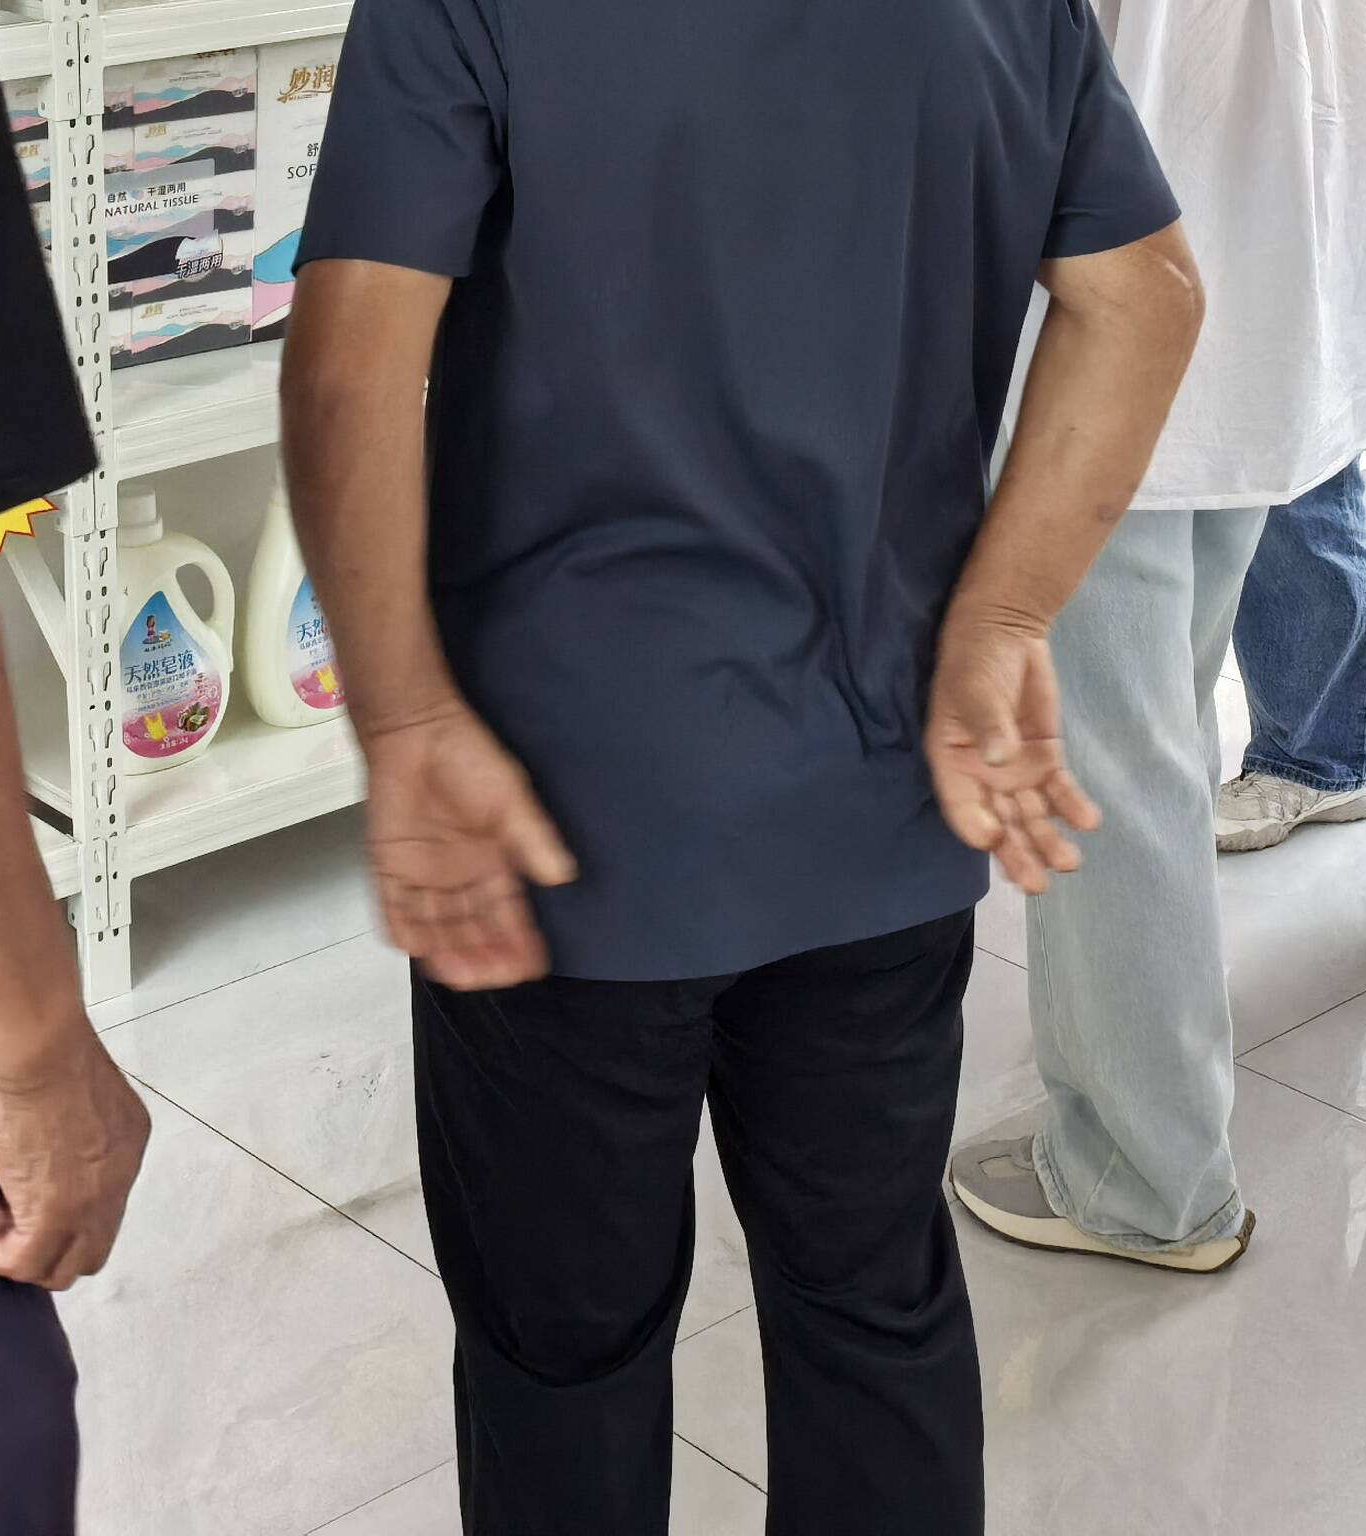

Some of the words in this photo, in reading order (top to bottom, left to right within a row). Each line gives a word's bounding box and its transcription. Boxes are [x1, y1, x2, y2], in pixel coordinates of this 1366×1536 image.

[287, 163, 317, 180] SOF
[107, 191, 128, 204] 自然
[147, 182, 186, 197] 干湿两用
[104, 201, 163, 218] NATURAL
[163, 194, 200, 208] TISSUE
[123, 649, 195, 686] 天然皂液
